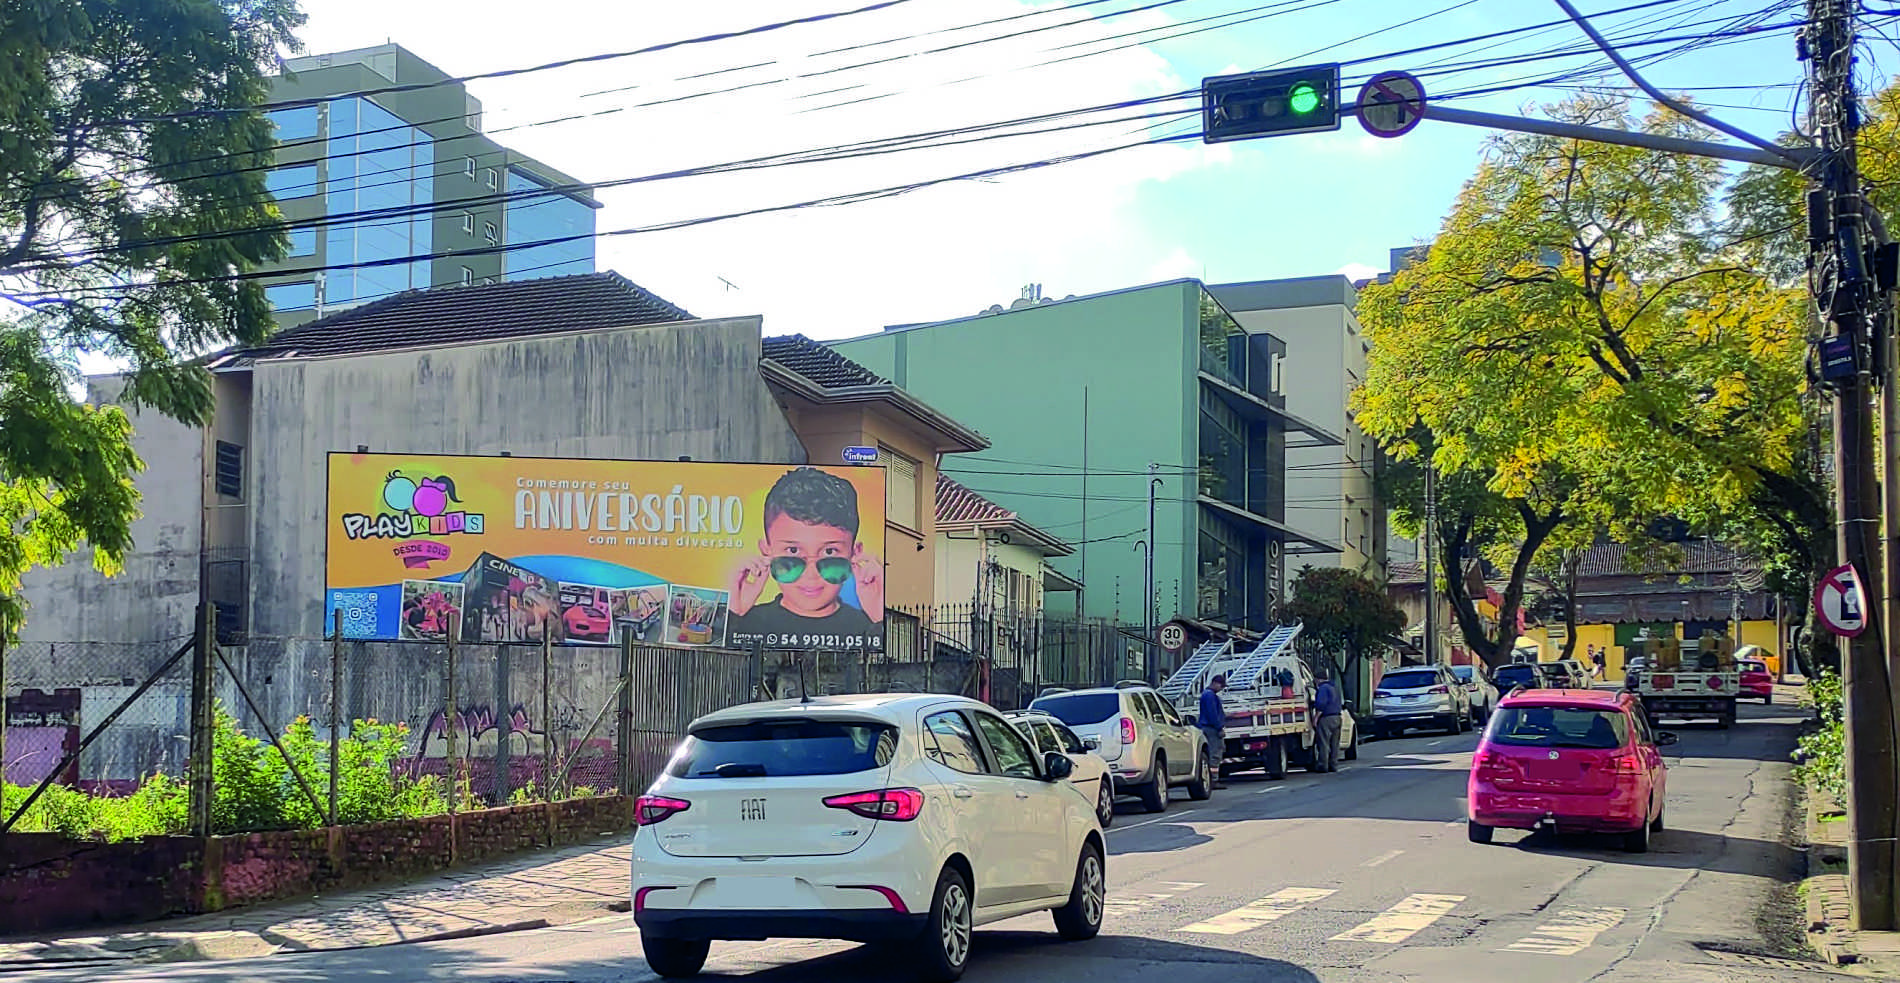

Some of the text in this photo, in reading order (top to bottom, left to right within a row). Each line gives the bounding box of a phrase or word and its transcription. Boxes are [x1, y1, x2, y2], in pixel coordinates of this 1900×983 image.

[517, 477, 630, 490] Comemore seu
[515, 484, 743, 534] ANIVERSÁRIO
[588, 535, 744, 549] com muita diversão
[393, 544, 423, 556] DESDE
[489, 559, 520, 577] CINE
[781, 633, 799, 645] 54
[1164, 628, 1181, 639] 30
[741, 798, 767, 821] FIAT
